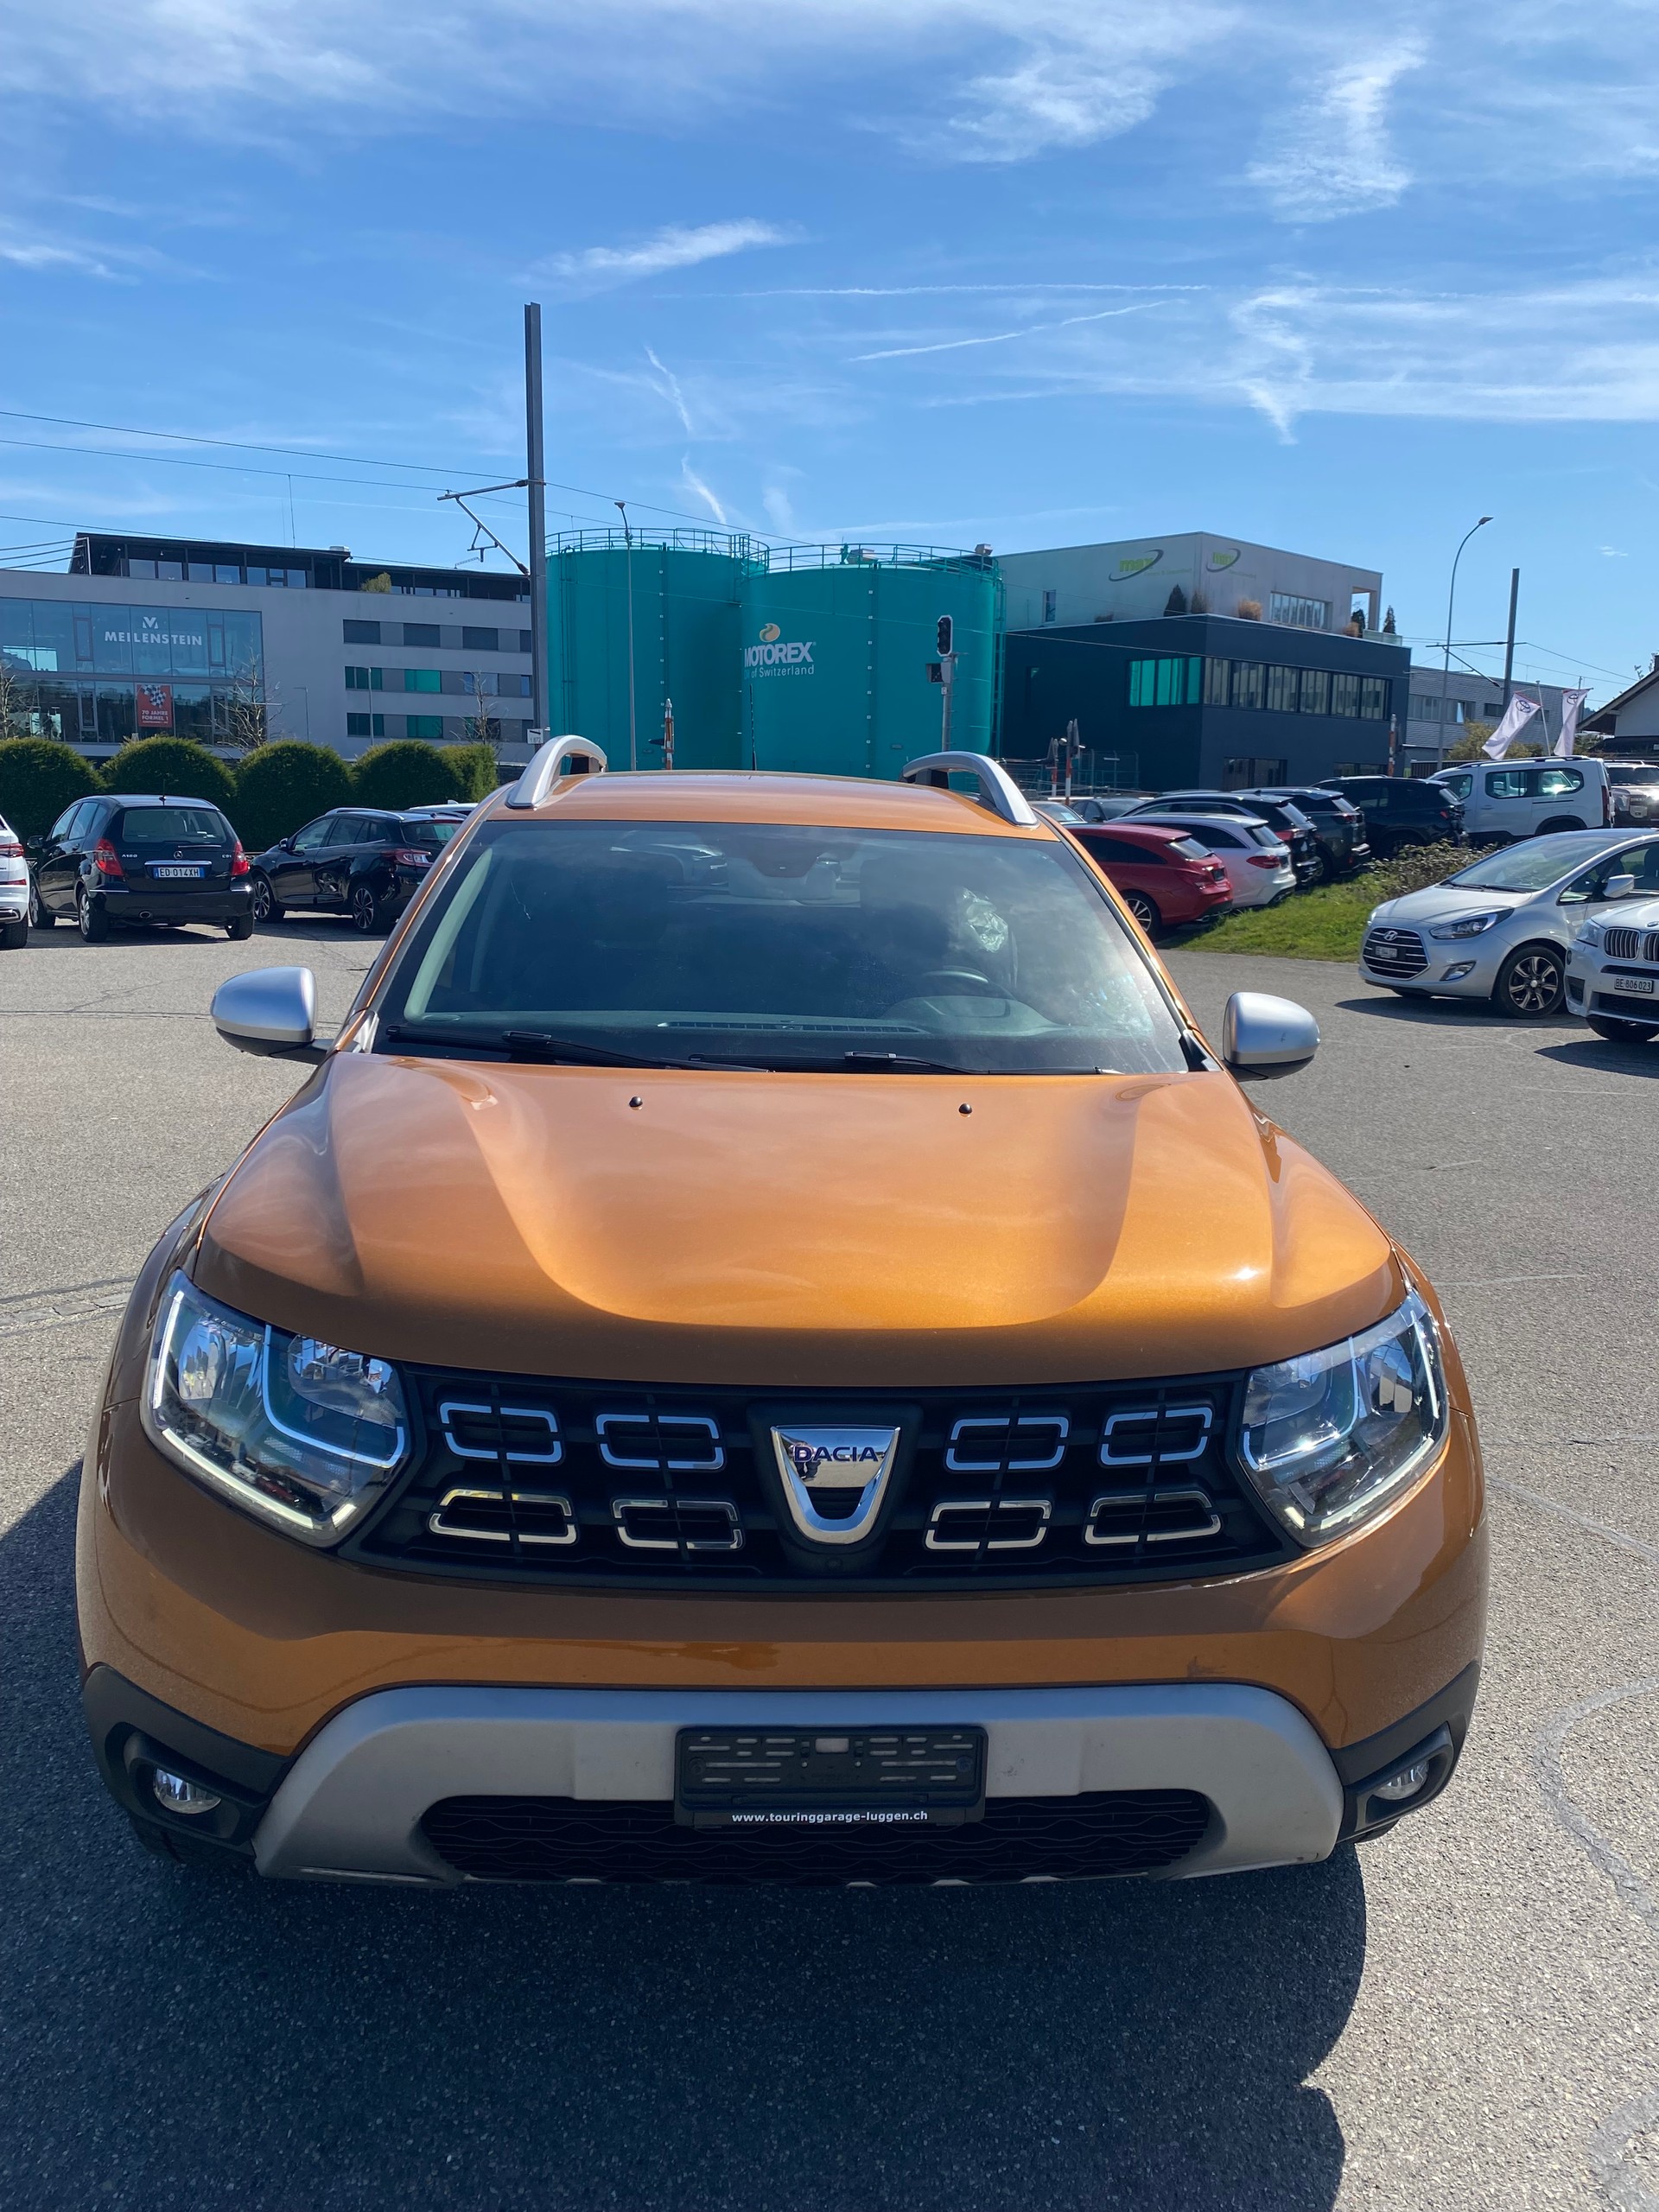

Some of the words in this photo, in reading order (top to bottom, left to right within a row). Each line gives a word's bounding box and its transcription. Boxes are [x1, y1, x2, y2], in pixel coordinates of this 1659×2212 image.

[105, 631, 202, 645] MEILENSTEIN
[744, 641, 814, 668] MOTOREX
[751, 667, 758, 678] of
[759, 664, 815, 678] Switzerland
[159, 868, 170, 877] ED
[173, 868, 199, 877] 014XH
[1616, 978, 1624, 988] BE
[793, 1446, 879, 1462] DACIA
[732, 1810, 928, 1823] www.touringgarage-luggen.ch
